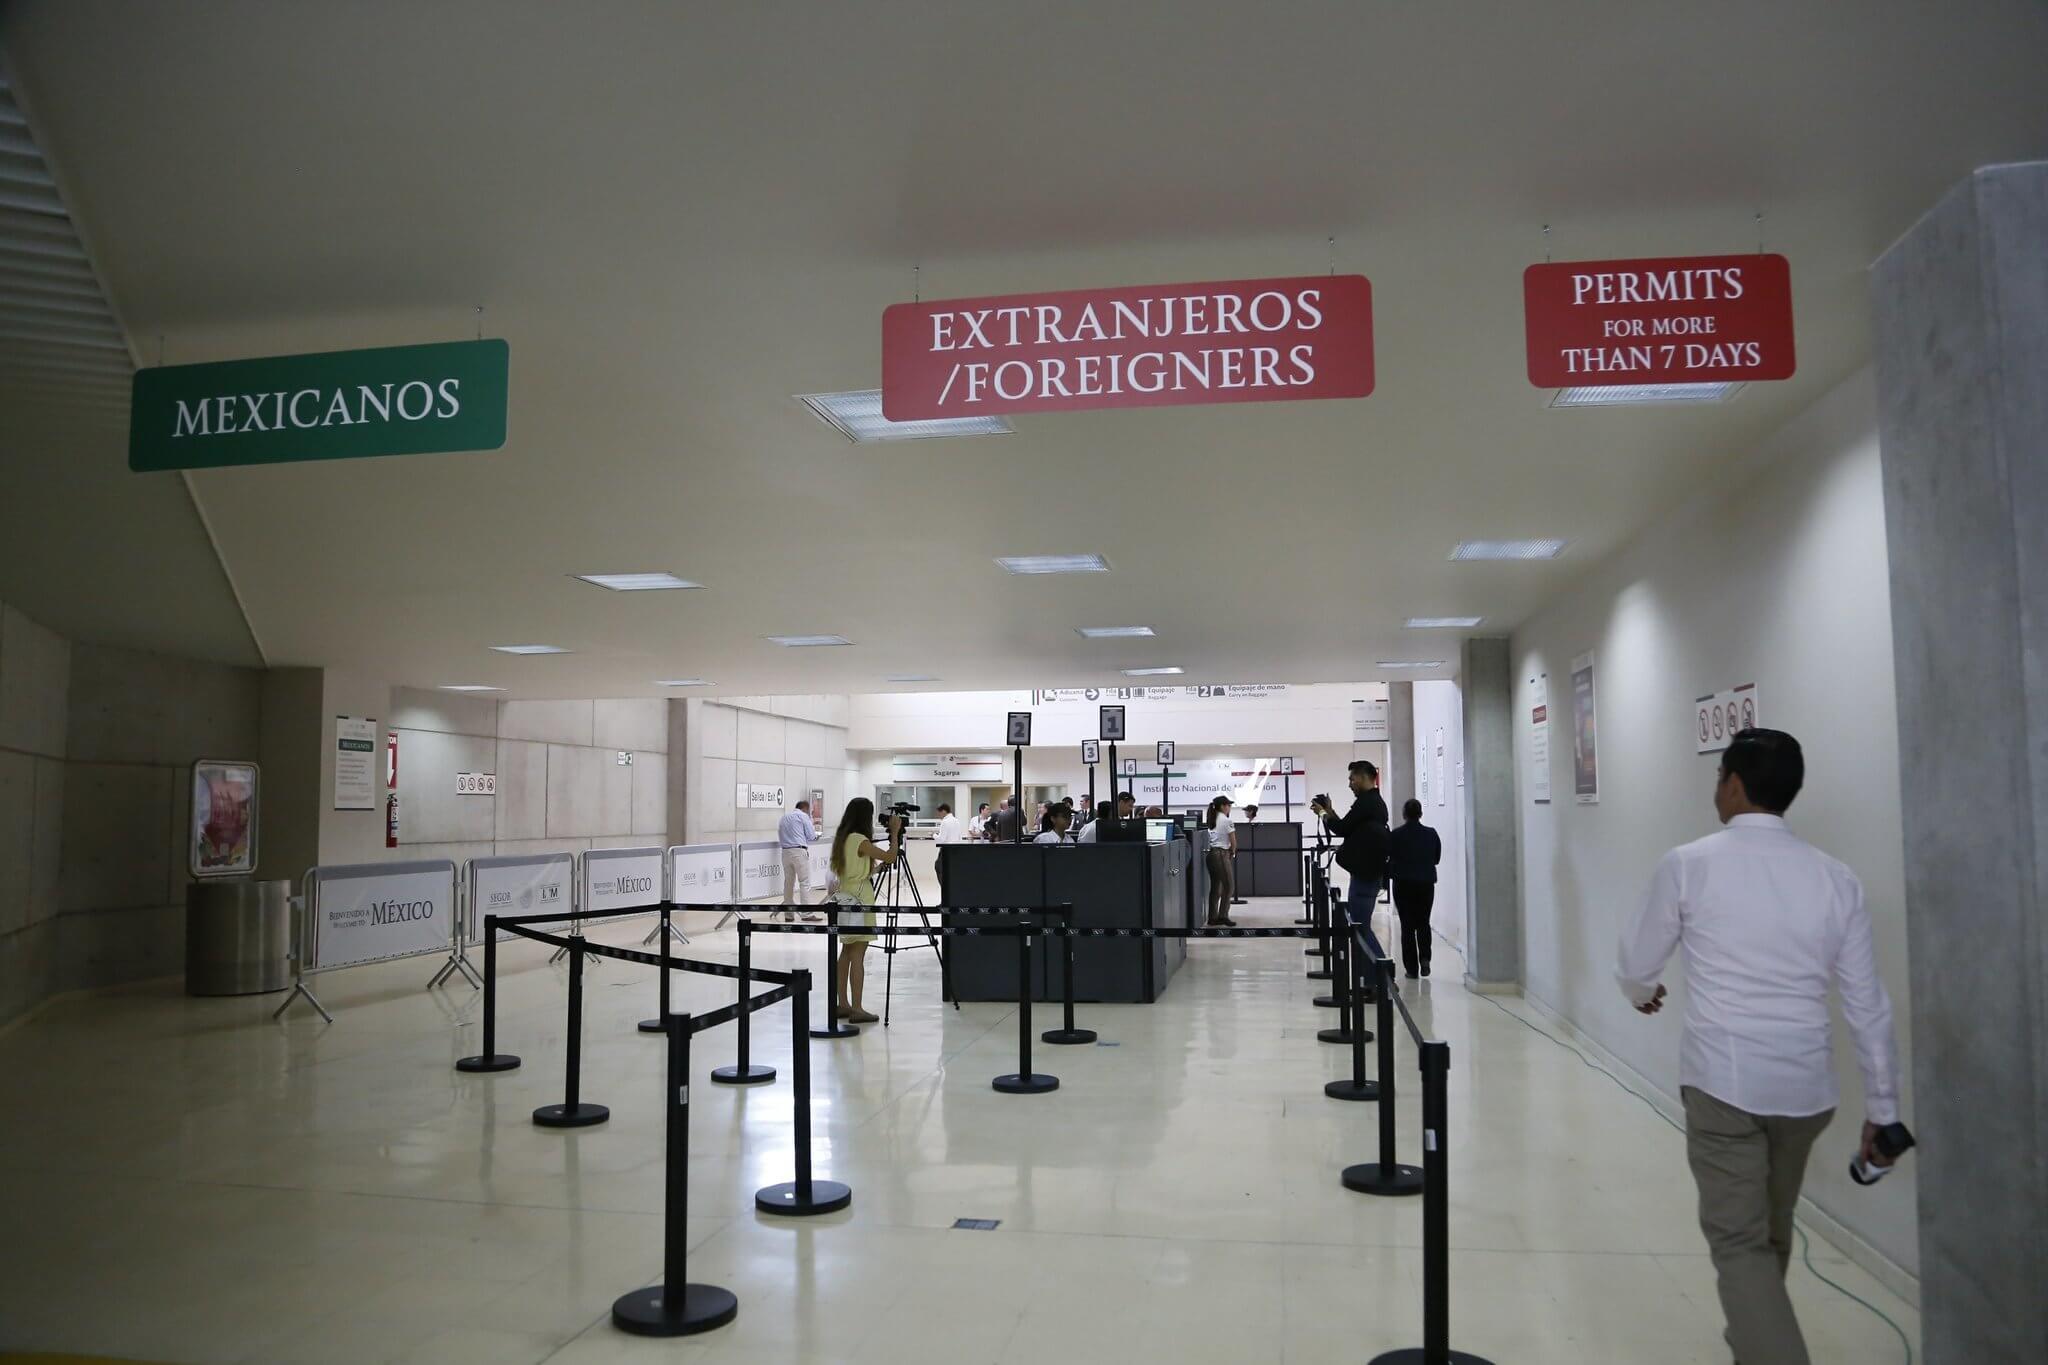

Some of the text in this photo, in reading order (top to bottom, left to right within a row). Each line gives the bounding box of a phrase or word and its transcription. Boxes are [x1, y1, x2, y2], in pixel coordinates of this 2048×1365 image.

[1571, 268, 1744, 305] PERMITS
[929, 290, 1322, 351] EXTRANJEROS
[1603, 316, 1716, 337] FOR MORE
[1561, 342, 1761, 373] THAN 7 DAYS
[937, 345, 1316, 405] /FOREIGNERS
[171, 378, 460, 438] MEXICANOS
[1014, 721, 1025, 738] 2
[1107, 716, 1119, 733] 1
[1087, 747, 1095, 759] 3
[1161, 748, 1170, 760] 4
[1127, 763, 1134, 773] 6
[1143, 784, 1180, 793] Instiuto
[1182, 783, 1219, 793] Nacional
[1221, 783, 1231, 792] de
[616, 875, 652, 895] MÉXICO
[329, 909, 365, 921] BIENVENIDO
[370, 899, 433, 926] MÉXICO
